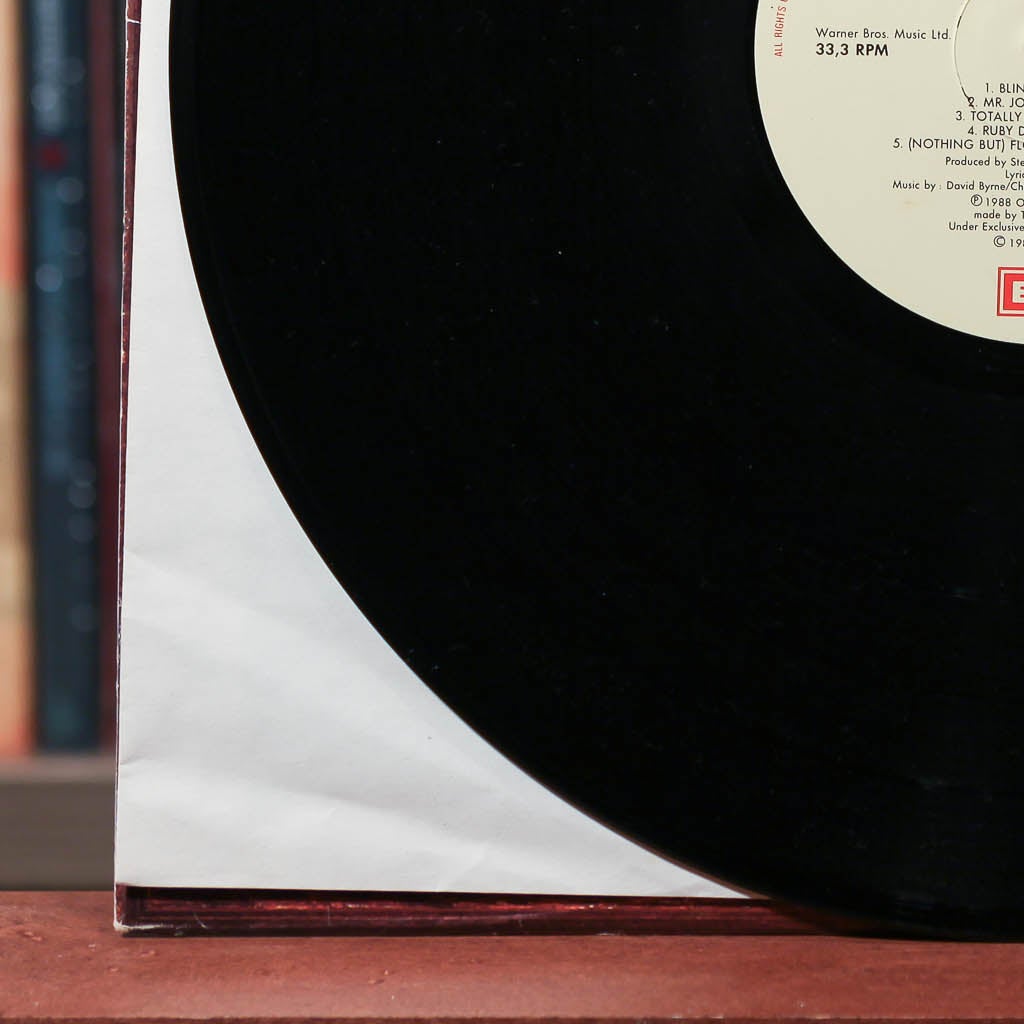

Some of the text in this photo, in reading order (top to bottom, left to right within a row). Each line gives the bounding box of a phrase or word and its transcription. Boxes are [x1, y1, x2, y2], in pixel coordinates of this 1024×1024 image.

[773, 5, 787, 38] RIGHTS
[815, 27, 951, 40] Warner Bros. Music Ltd.
[773, 42, 783, 57] ALL
[815, 43, 889, 58] 33,3 RPM
[985, 83, 994, 94] 1.
[968, 96, 978, 108] 2.
[983, 97, 1005, 108] MR.
[955, 110, 965, 121] 3.
[970, 110, 1022, 122] TOTALLY
[967, 125, 977, 136] 4.
[982, 125, 1014, 136] RUBY
[892, 137, 903, 149] 5.
[908, 137, 974, 152] (NOTHING
[979, 139, 1005, 153] BUT)
[945, 156, 990, 167] Produced
[994, 157, 1007, 169] by
[892, 180, 920, 190] Music
[924, 180, 936, 192] by
[946, 180, 974, 191] David
[986, 197, 1011, 207] 1988
[973, 209, 1001, 219] made
[1005, 209, 1017, 222] by
[948, 221, 978, 231] Under
[982, 221, 1024, 232] Exclusive
